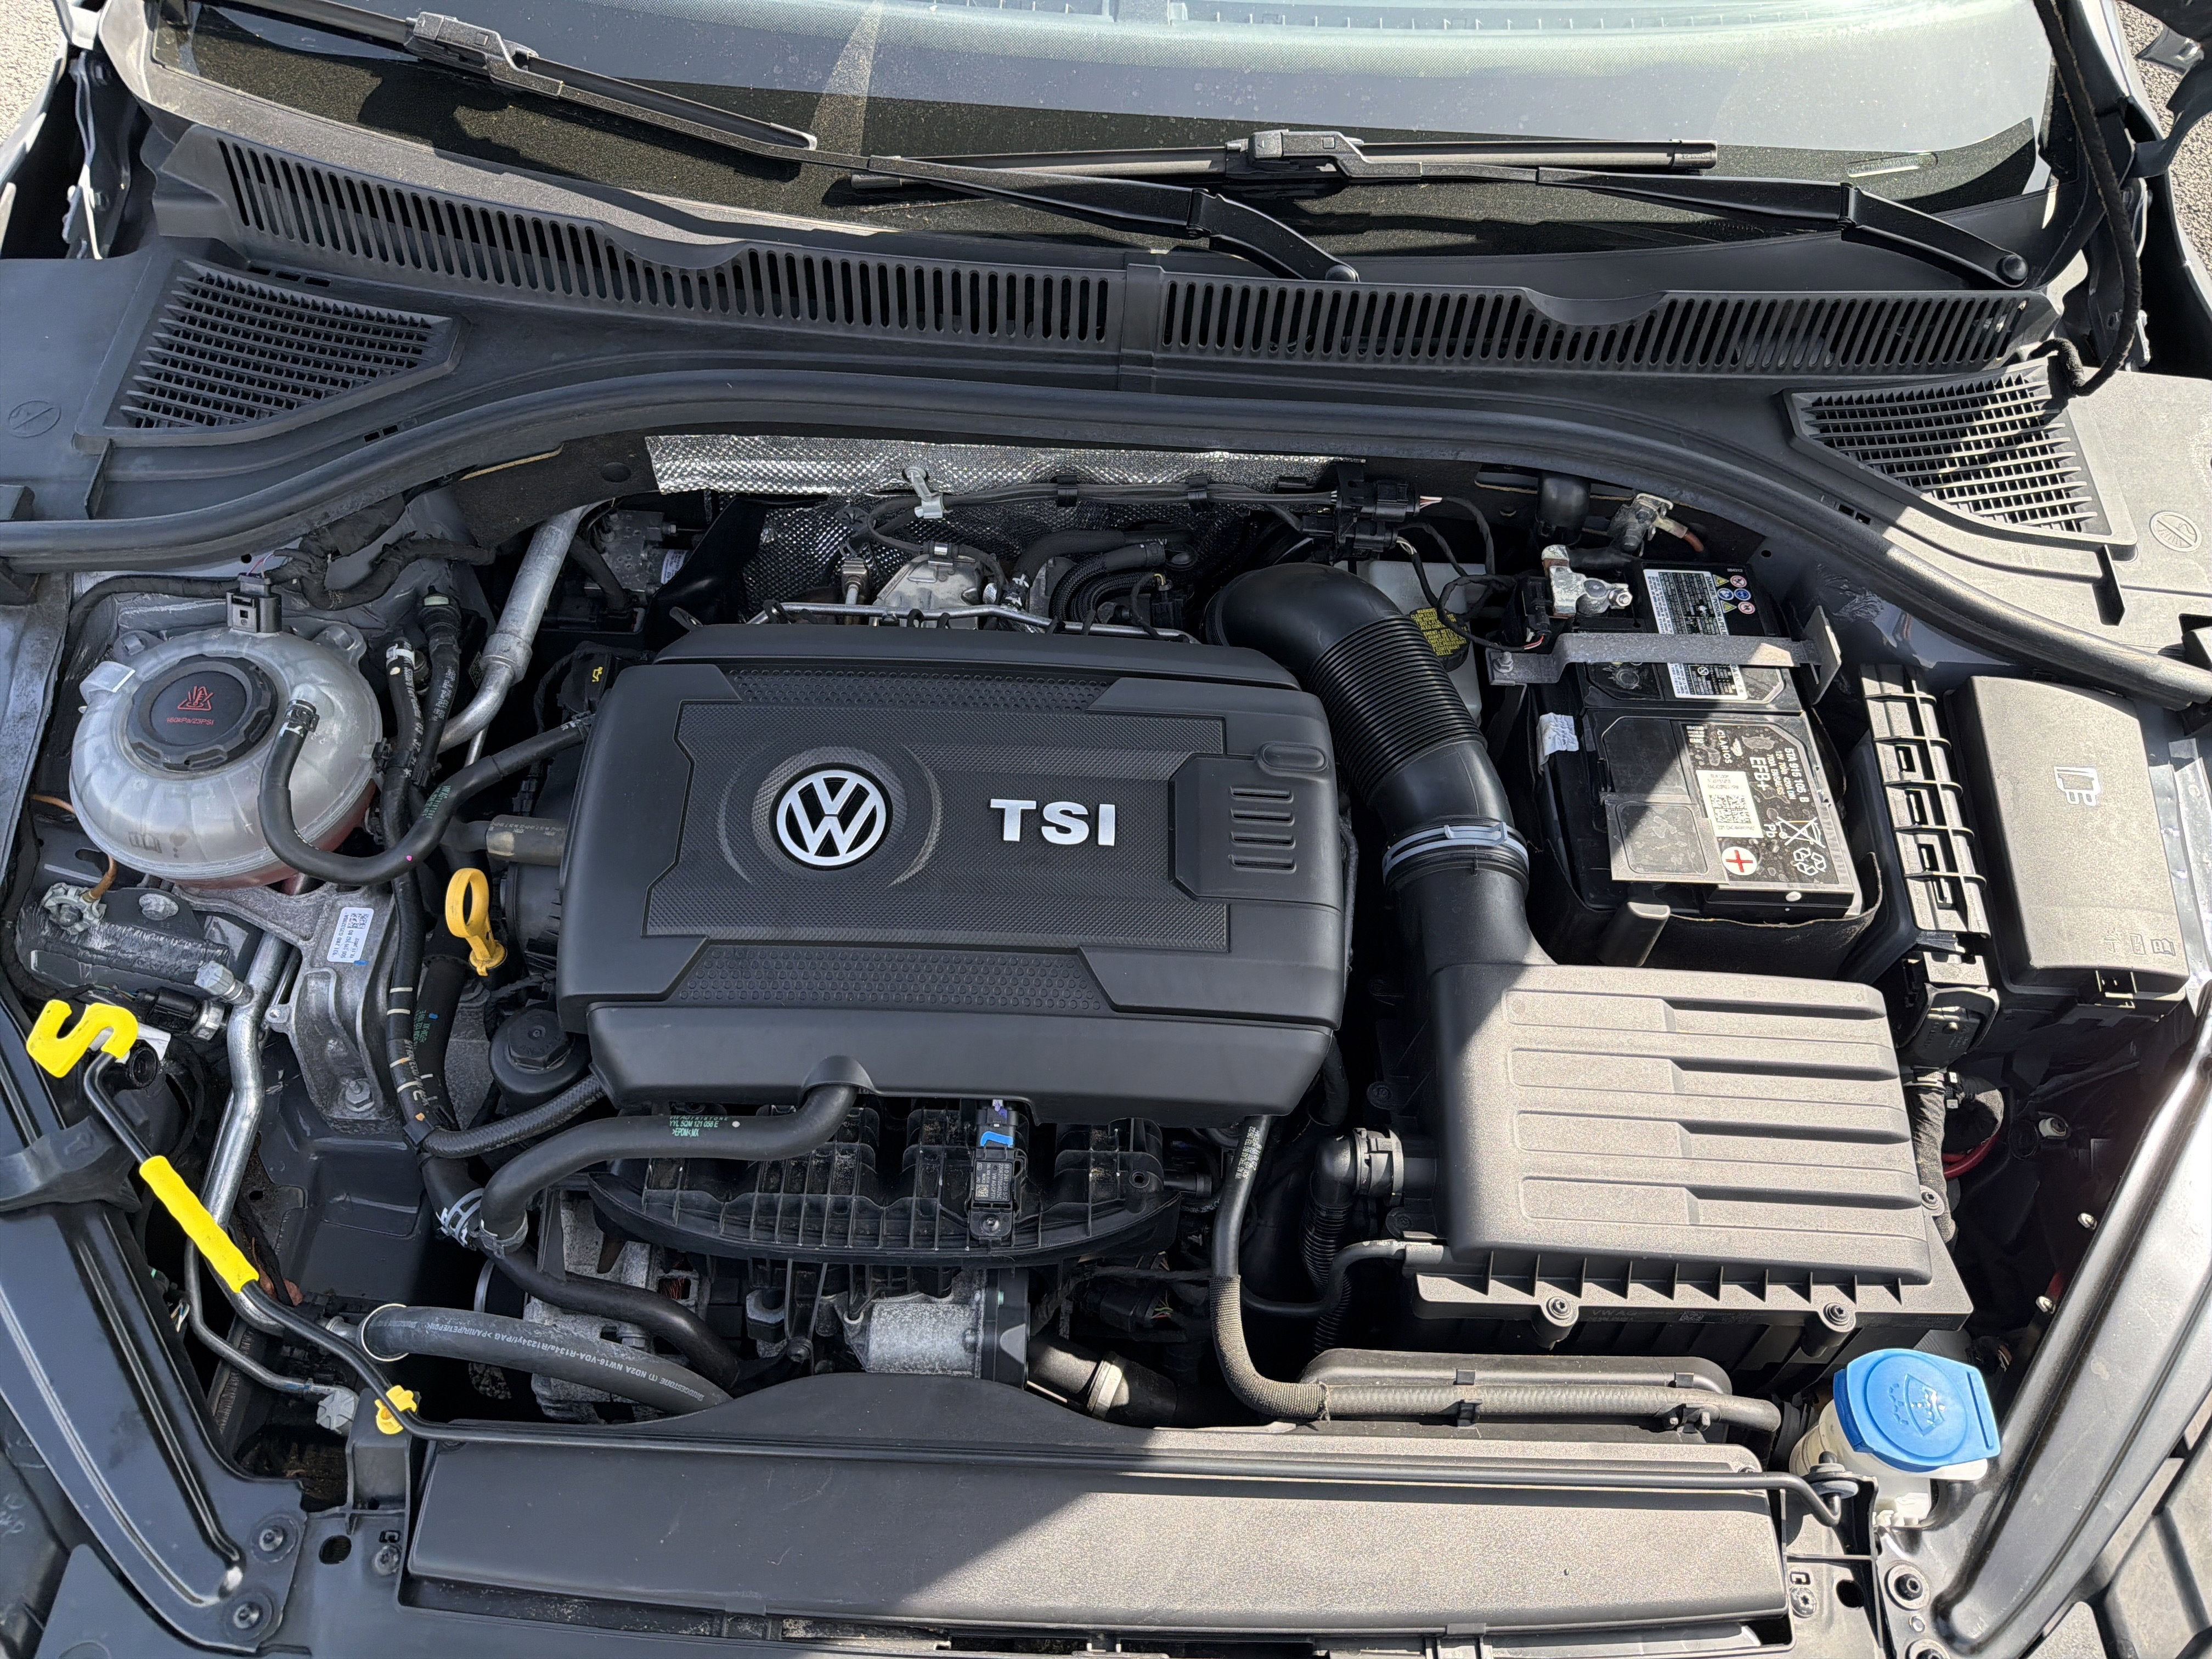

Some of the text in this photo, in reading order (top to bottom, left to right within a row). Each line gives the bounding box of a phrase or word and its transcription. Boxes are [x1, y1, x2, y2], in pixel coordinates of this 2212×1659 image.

[1717, 729, 1733, 764] CLARIOS
[1785, 748, 1797, 762] 5TA
[1750, 757, 1771, 791] EFB+
[1790, 763, 1802, 777] 915
[990, 798, 1116, 847] TSI
[1763, 823, 1778, 838] Pb
